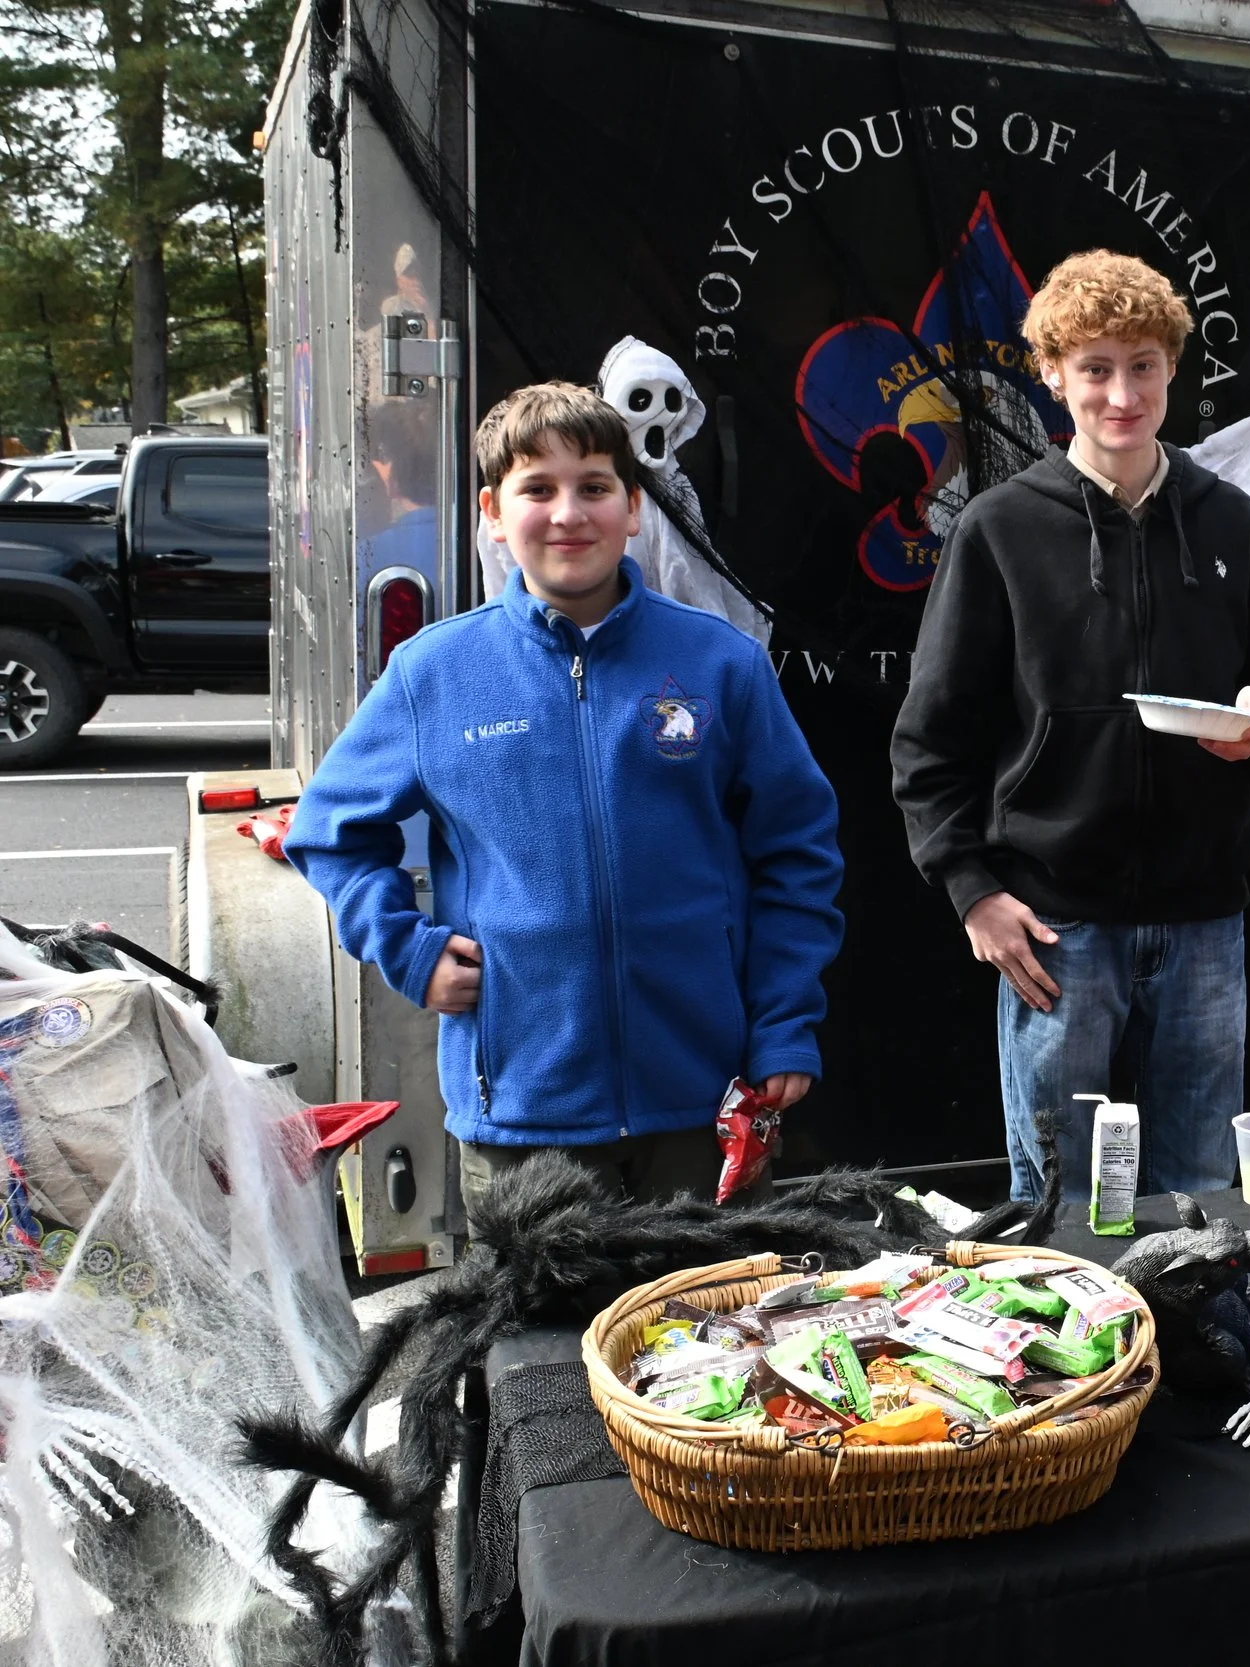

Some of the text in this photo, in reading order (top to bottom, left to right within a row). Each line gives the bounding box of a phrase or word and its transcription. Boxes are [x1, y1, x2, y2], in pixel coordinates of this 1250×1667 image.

[696, 104, 1239, 390] BOY SCOUTS OF AMERICA
[477, 719, 529, 739] MARCUS
[865, 1325, 887, 1335] SIZE
